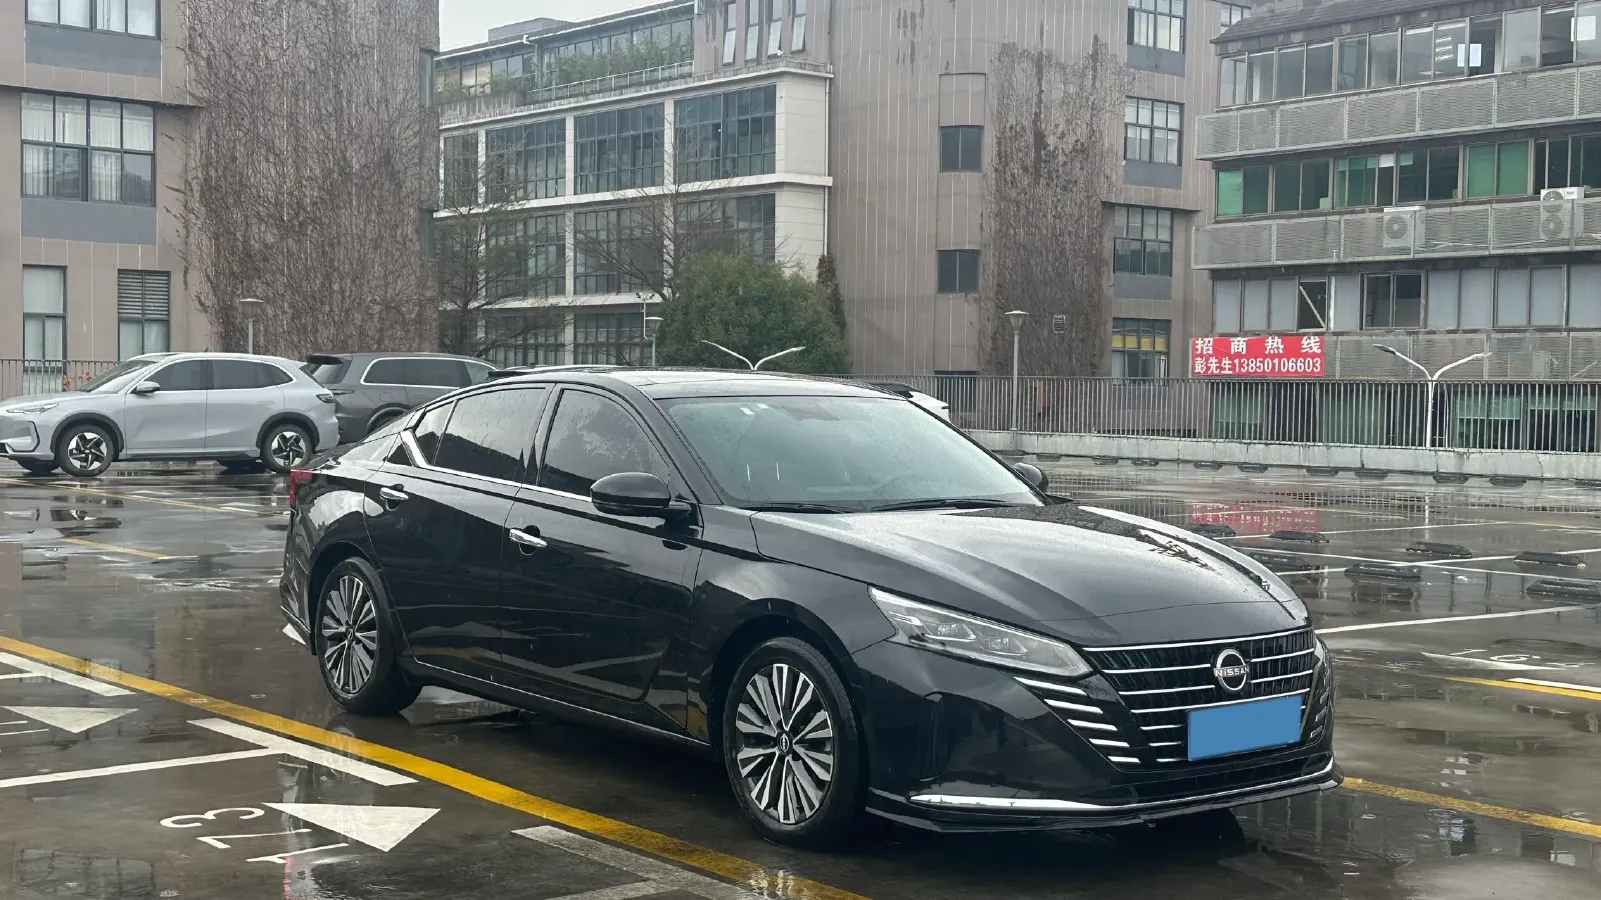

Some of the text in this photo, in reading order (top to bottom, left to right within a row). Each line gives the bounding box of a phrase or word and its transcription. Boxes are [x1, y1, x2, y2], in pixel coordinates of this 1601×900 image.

[1195, 336, 1321, 355] 招商热线
[1194, 357, 1321, 374] 彭先生13850106603
[1214, 665, 1250, 677] NISSAN
